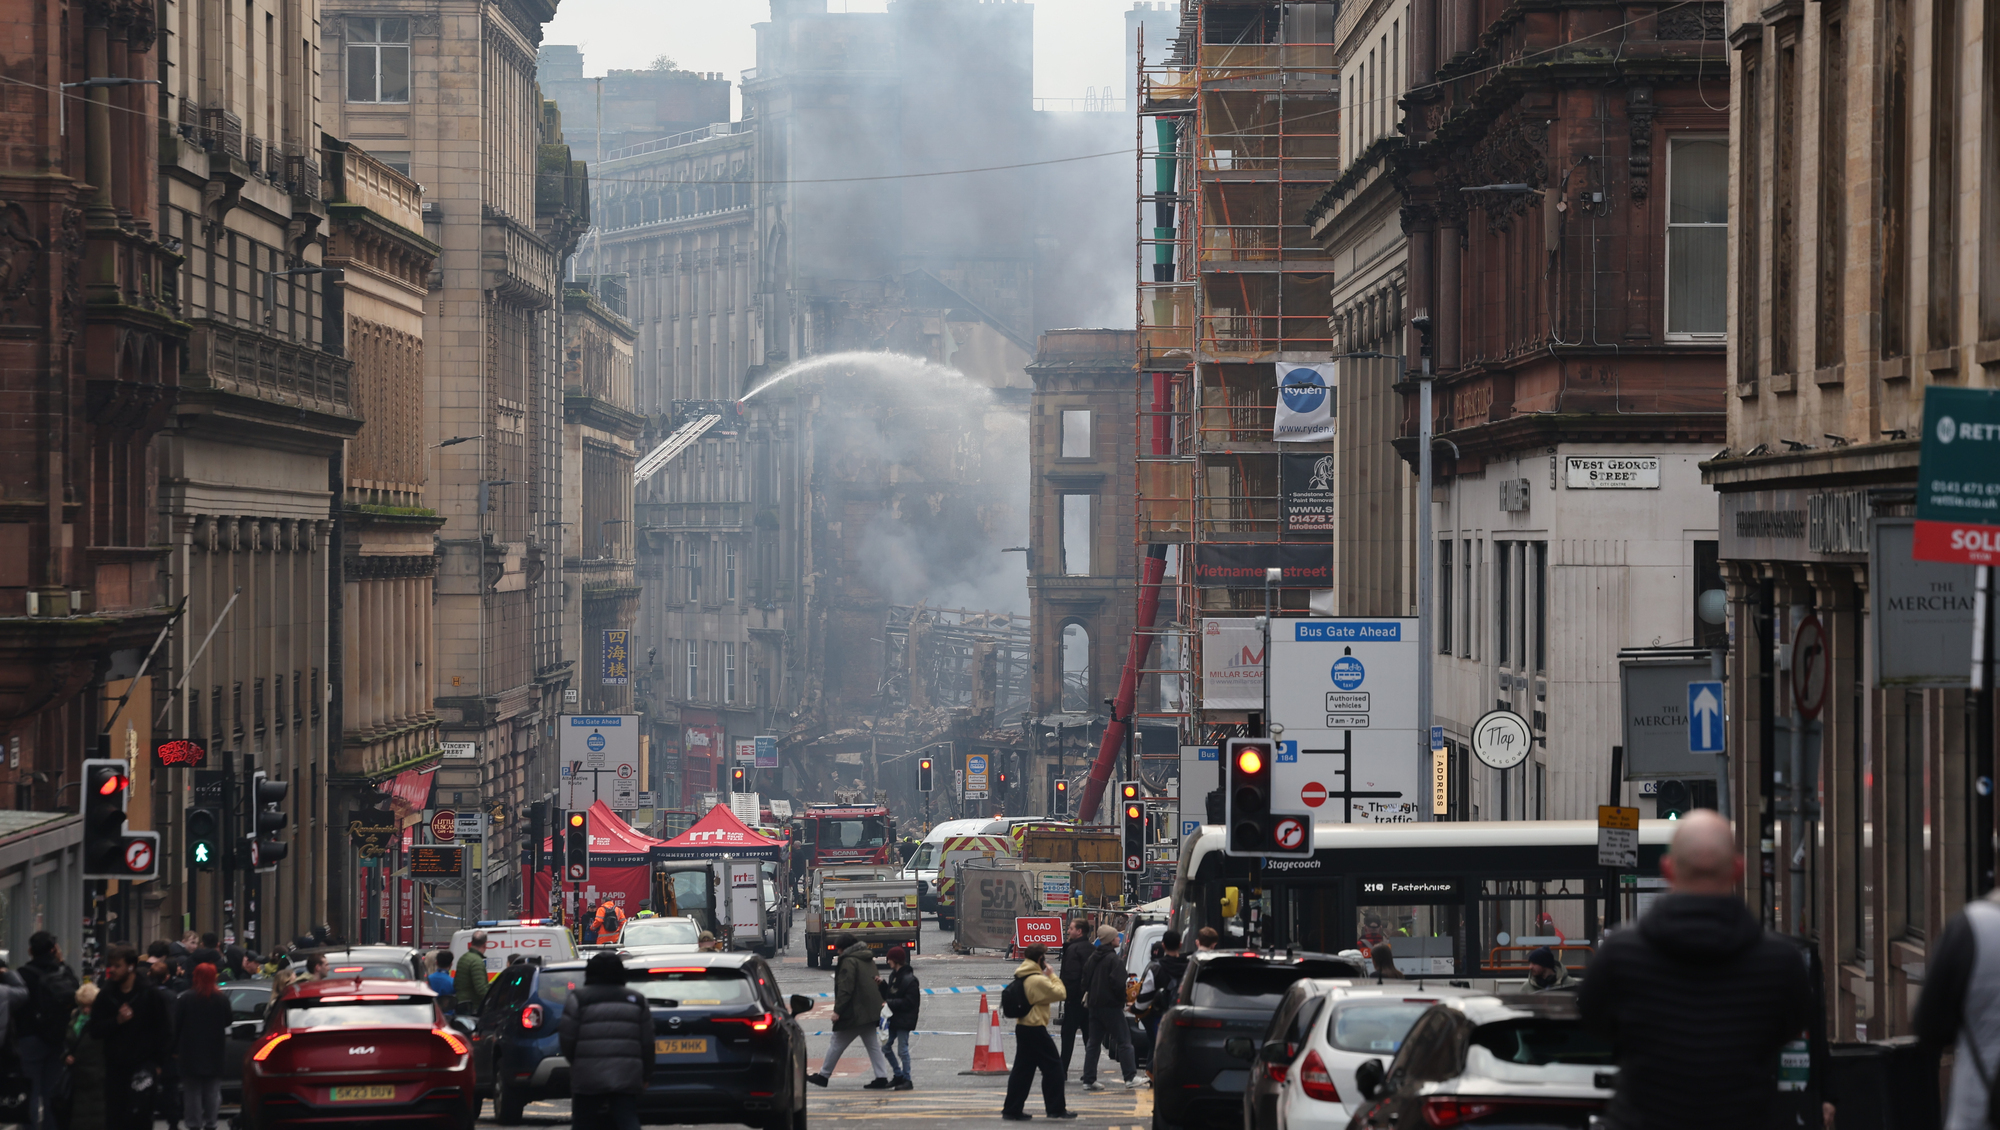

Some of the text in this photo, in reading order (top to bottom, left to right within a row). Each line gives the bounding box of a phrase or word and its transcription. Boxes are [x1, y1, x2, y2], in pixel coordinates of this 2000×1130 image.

[1959, 422, 2000, 441] RETT
[1571, 460, 1657, 470] WEST GEORGE
[1589, 471, 1637, 481] STREET
[1289, 515, 1326, 523] 01475
[1196, 564, 1327, 577] Vietnames street
[1930, 582, 1954, 592] THE
[1300, 626, 1397, 636] Bus Gate Ahead
[607, 631, 627, 677] 四海楼
[1662, 705, 1680, 713] THE
[1634, 715, 1689, 727] MERCHA
[1481, 750, 1523, 764] GLASGOW
[689, 829, 726, 841] rrt
[1268, 859, 1321, 871] Stagecoach
[733, 872, 748, 882] rrt
[1364, 883, 1384, 892] X19
[337, 1087, 367, 1099] SK23
